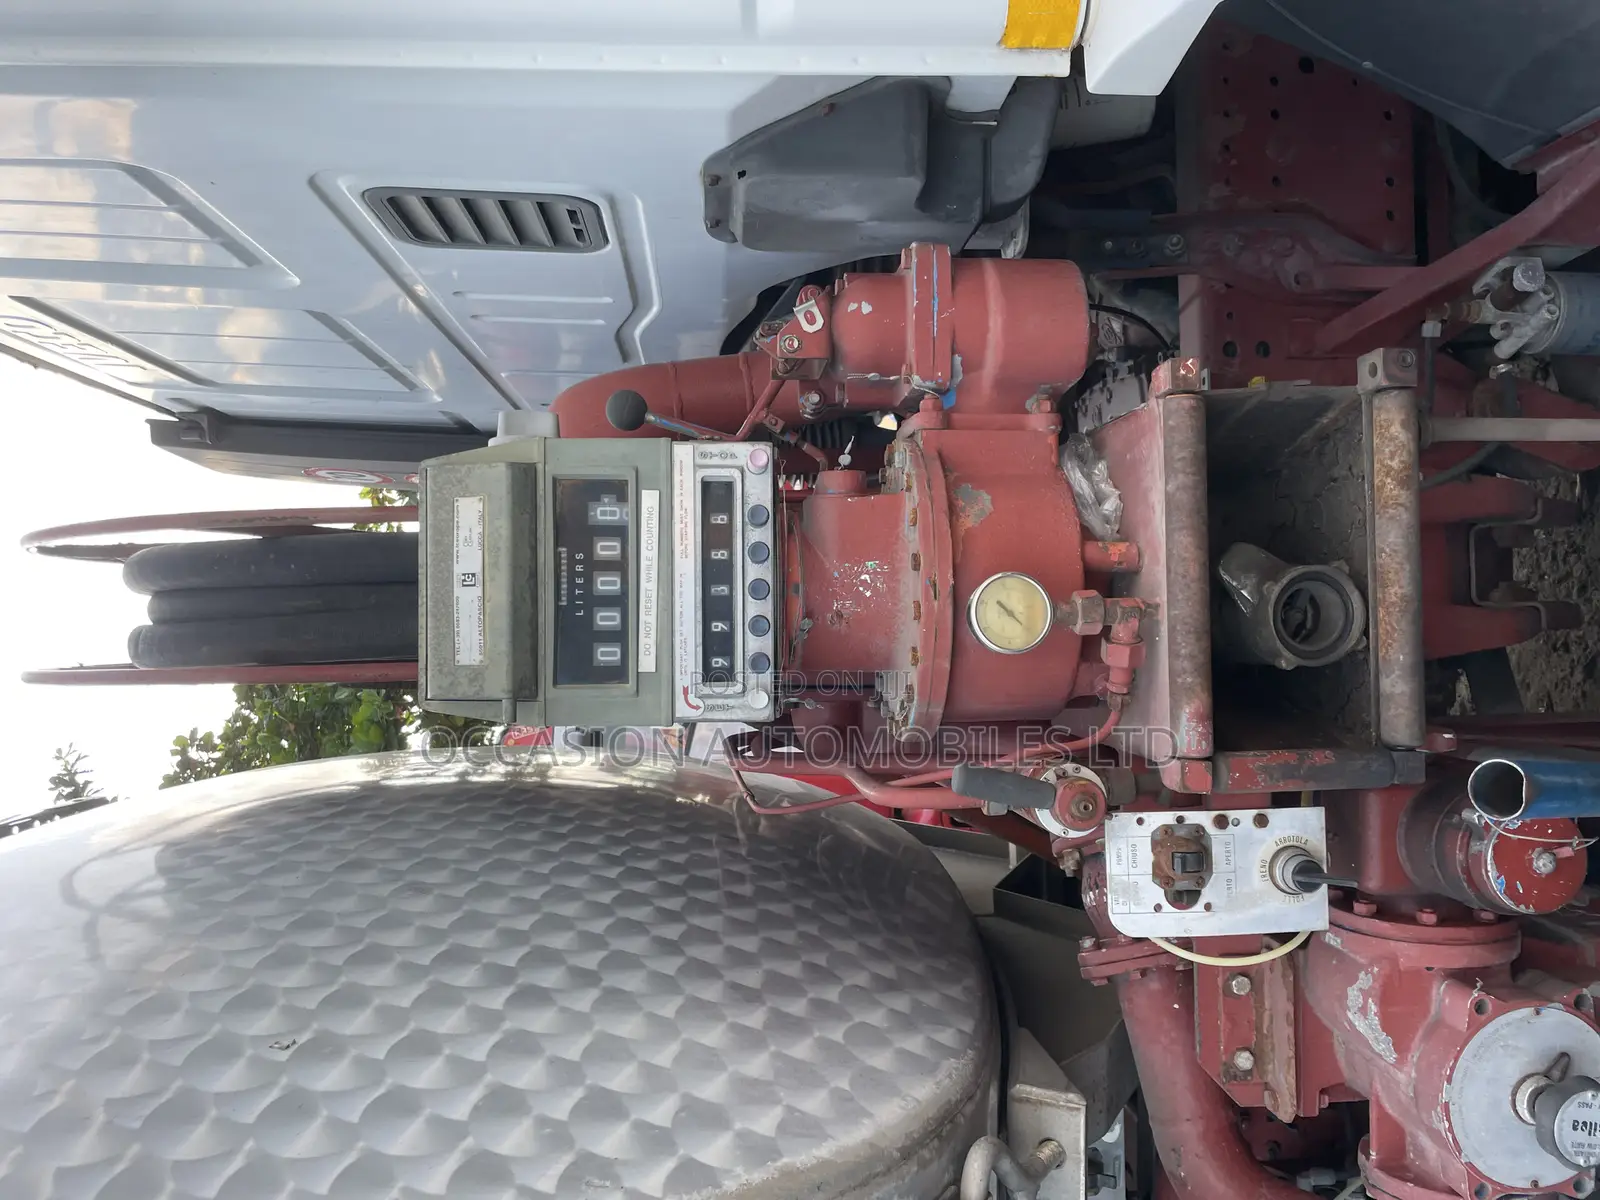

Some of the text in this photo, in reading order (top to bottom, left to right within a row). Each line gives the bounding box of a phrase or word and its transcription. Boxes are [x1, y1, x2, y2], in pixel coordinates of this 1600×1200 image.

[575, 552, 584, 616] LITERS
[643, 506, 655, 656] DO NOT RESET WHILE COUNTING
[706, 703, 734, 711] SET
[1274, 836, 1309, 847] ARROTOLA
